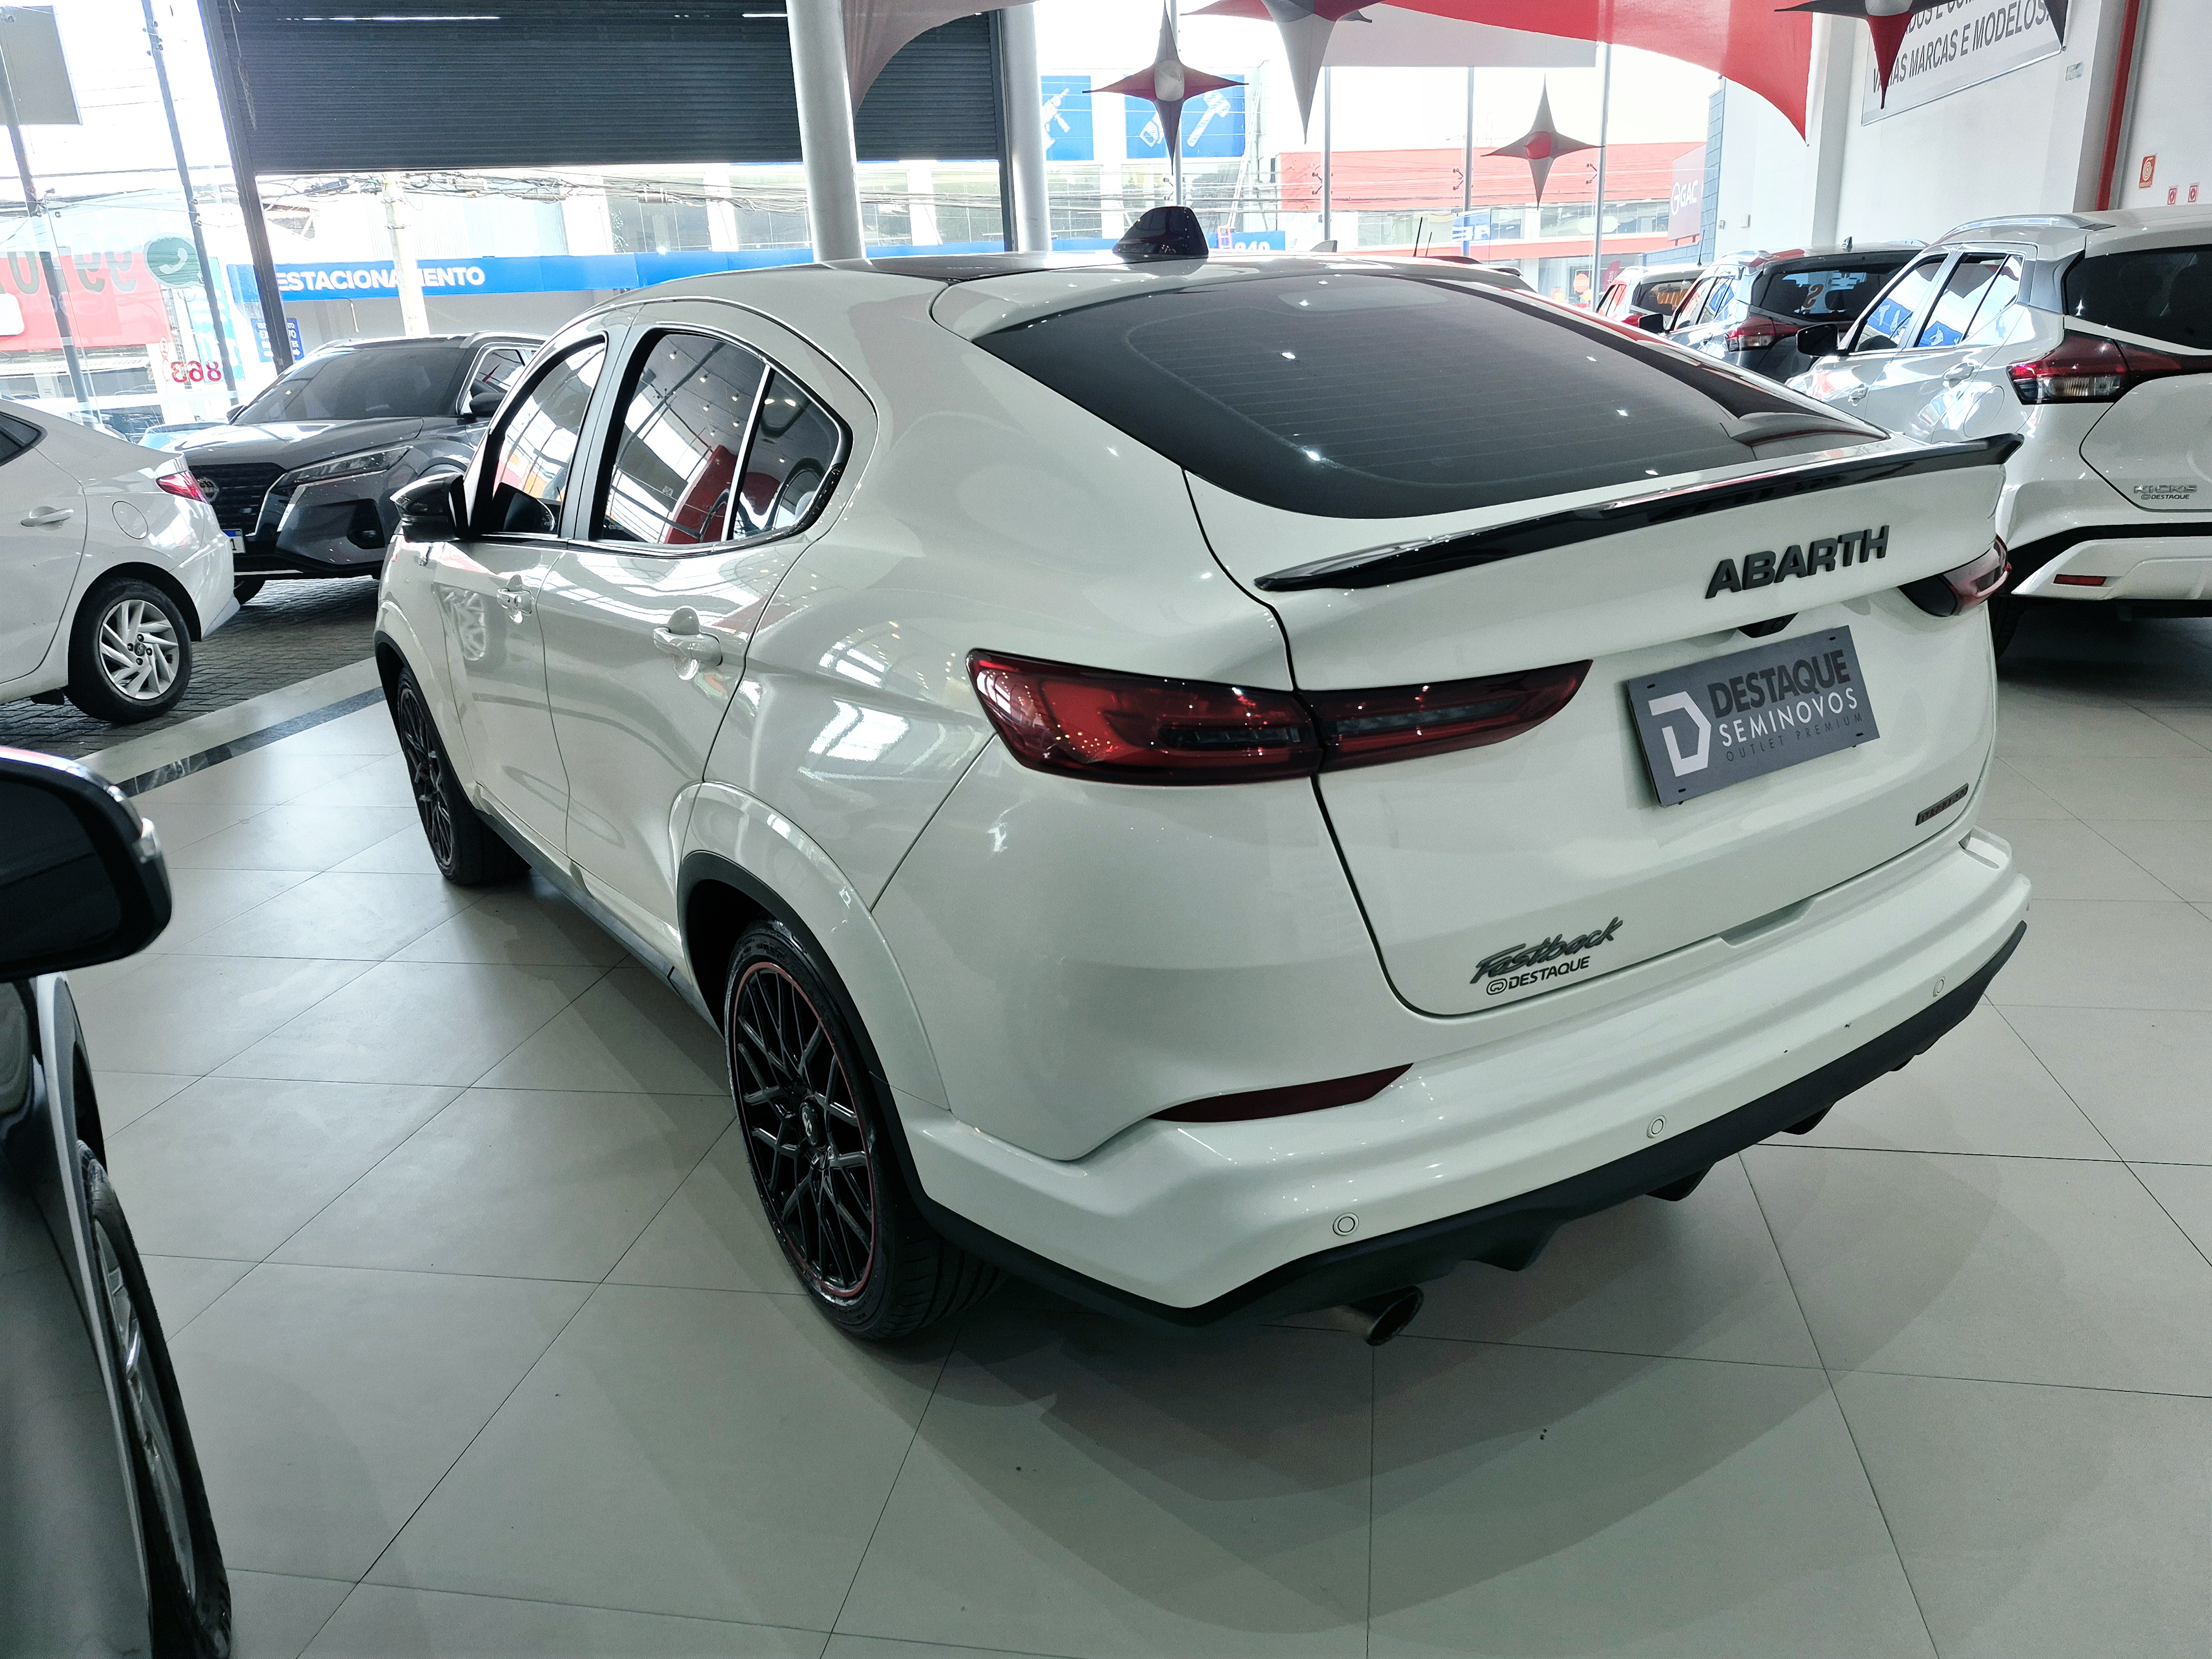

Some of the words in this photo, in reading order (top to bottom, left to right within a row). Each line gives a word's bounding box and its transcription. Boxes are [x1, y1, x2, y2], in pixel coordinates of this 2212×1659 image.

[1909, 29, 1958, 78] MARCAS
[1960, 23, 1971, 56] E
[1680, 179, 1698, 207] GAC
[2133, 484, 2198, 494] KICKS
[1705, 525, 1890, 599] ABARTH
[1708, 649, 1851, 719] DESTAQUE
[1719, 687, 1858, 747] SEMINOVOS
[1726, 735, 1785, 762] OUTLET
[1796, 712, 1864, 741] PREMIUM
[1469, 916, 1624, 984] Fastback
[1508, 955, 1591, 990] DESTAQUE
